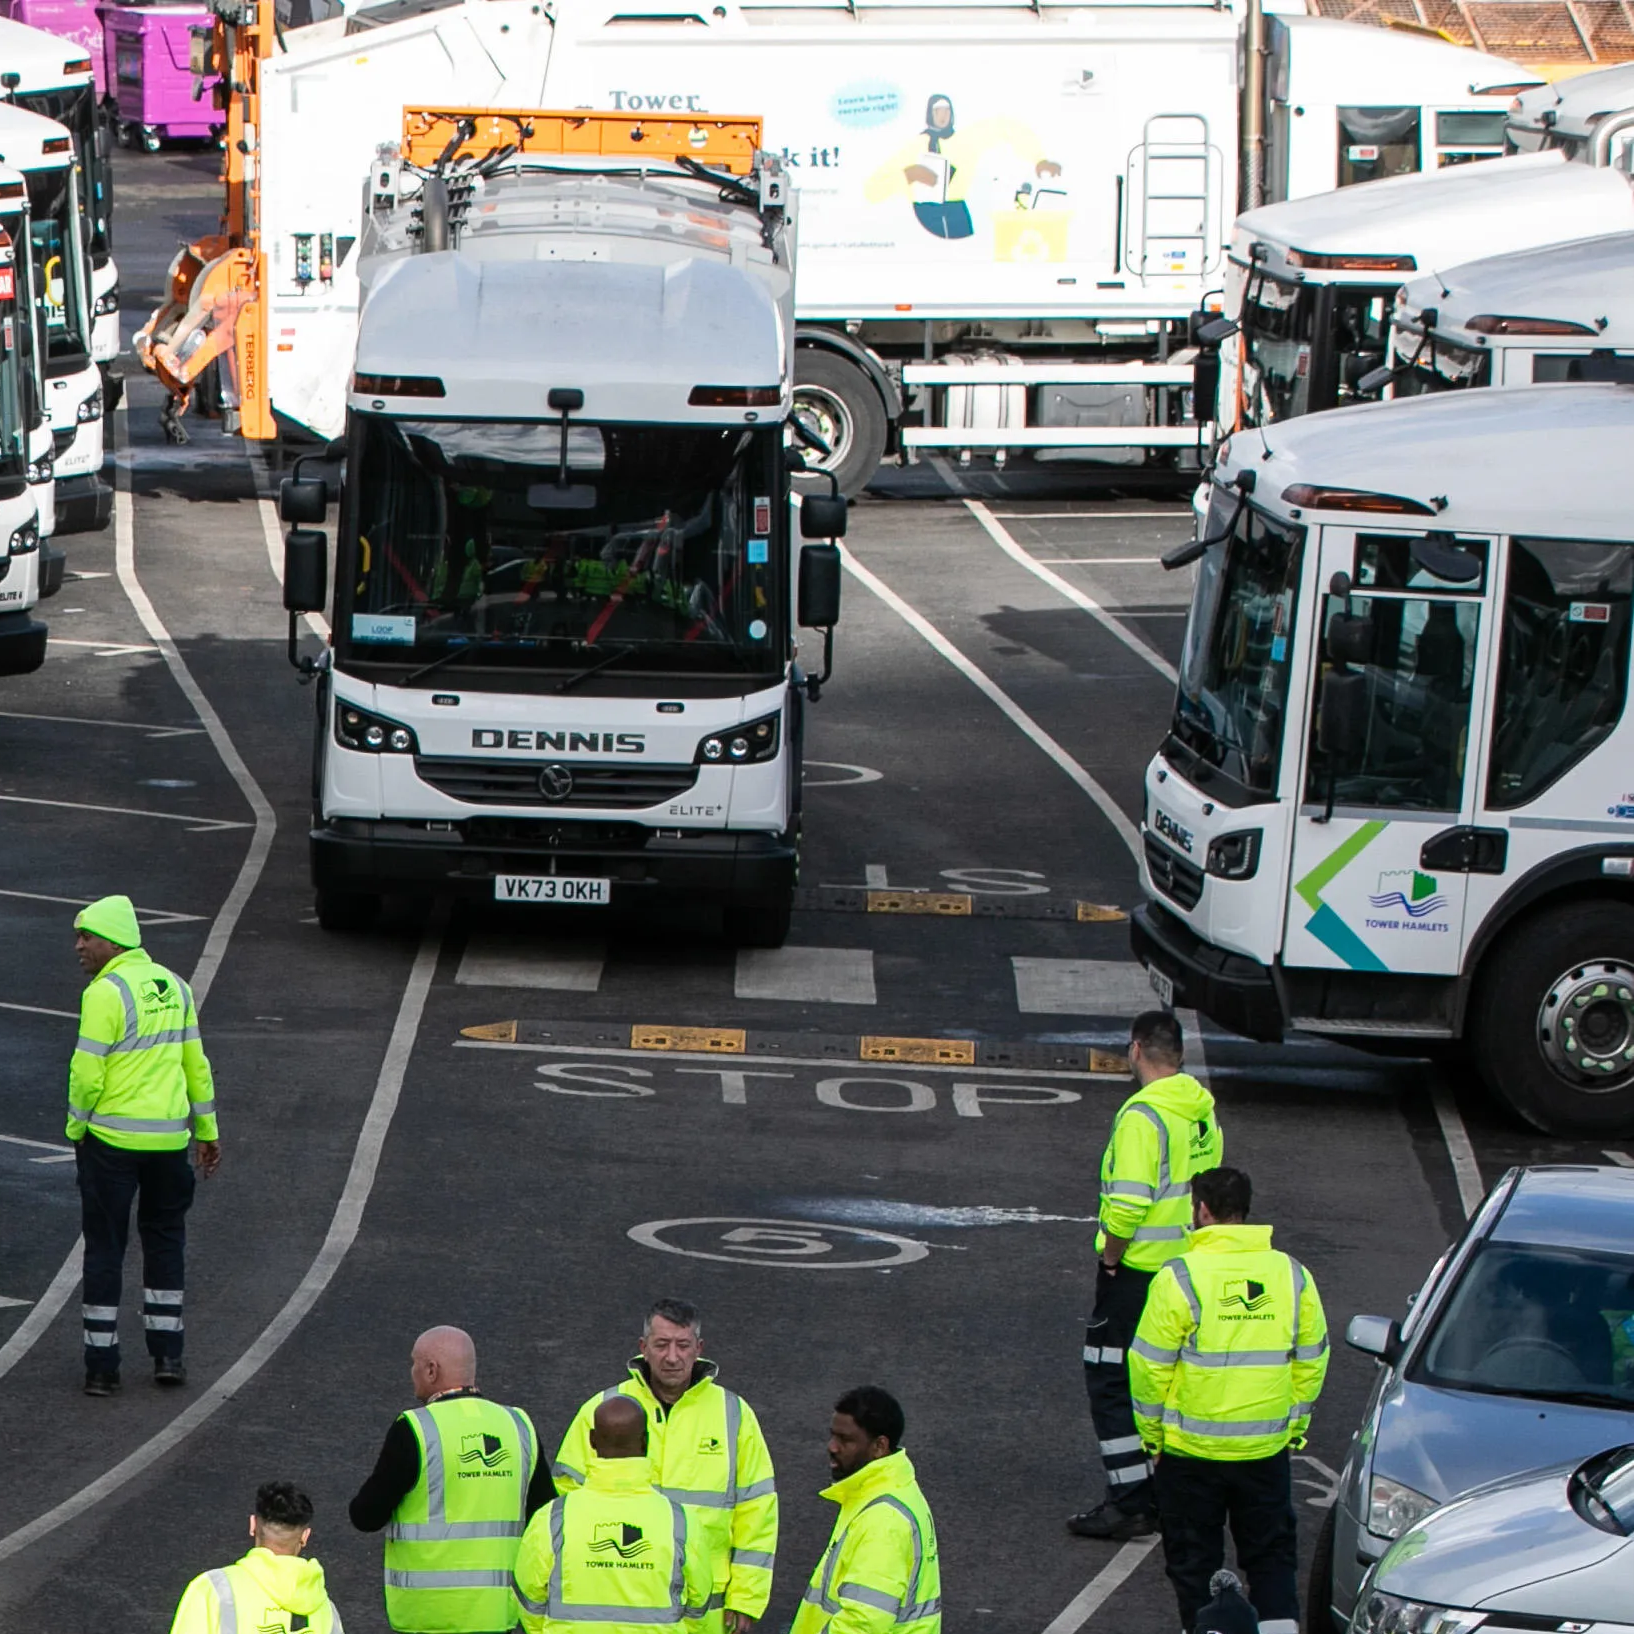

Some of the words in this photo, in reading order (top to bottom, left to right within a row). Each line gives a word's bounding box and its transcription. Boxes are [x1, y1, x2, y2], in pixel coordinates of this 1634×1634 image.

[609, 91, 700, 110] Tower
[811, 147, 839, 168] it!
[471, 728, 646, 753] DENNIS
[504, 878, 556, 898] VK73
[562, 881, 602, 900] OKH
[1364, 919, 1399, 929] TOWER
[1402, 921, 1449, 933] HAMLETS
[533, 1063, 1082, 1117] STOP
[720, 1226, 833, 1256] 5
[457, 1471, 481, 1479] TOWER
[586, 1561, 614, 1569] TOWER
[615, 1561, 654, 1570] HAMLETS
